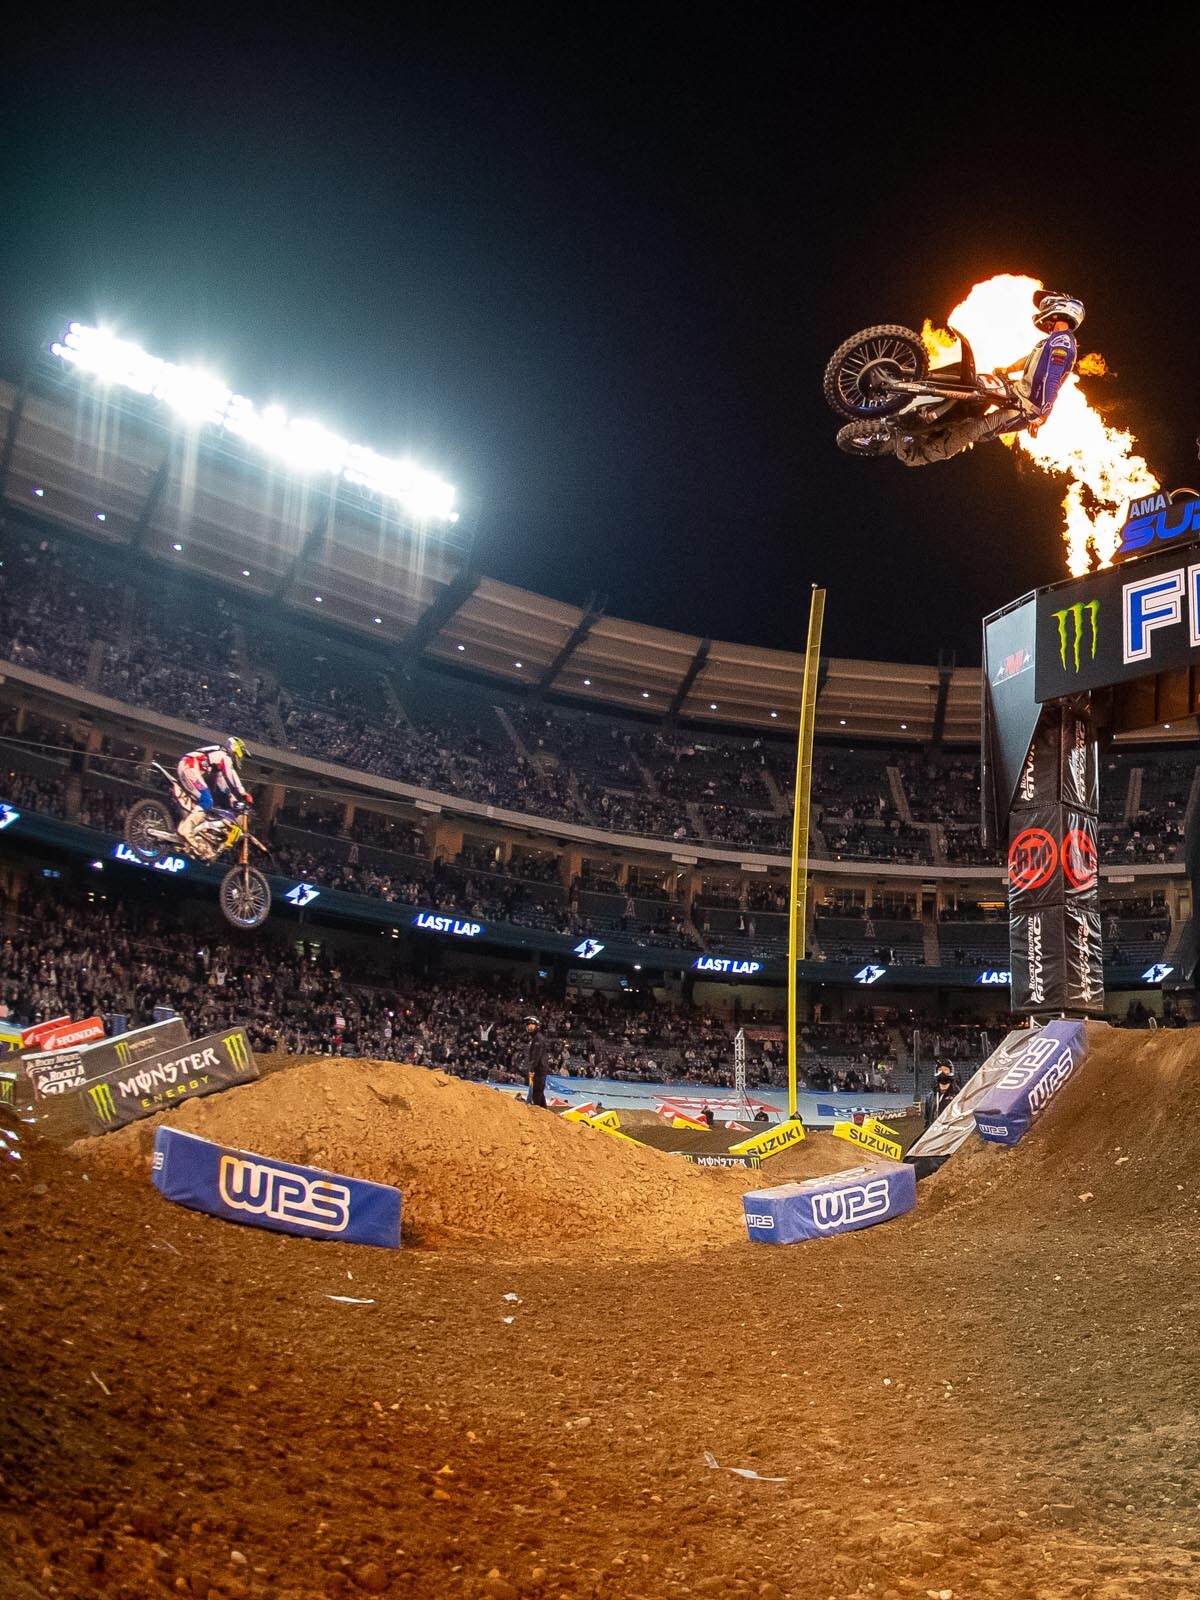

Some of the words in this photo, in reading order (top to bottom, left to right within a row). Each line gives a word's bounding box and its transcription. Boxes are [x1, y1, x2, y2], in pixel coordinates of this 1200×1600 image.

[1130, 494, 1166, 518] AMA
[417, 913, 453, 932] LAST
[453, 920, 481, 937] LAP
[697, 957, 731, 972] LAST
[732, 960, 760, 974] LAP
[56, 1026, 103, 1047] HONDA
[50, 1068, 77, 1081] ROCKY
[996, 1038, 1060, 1090] WPS
[142, 1076, 209, 1108] ENERGY
[1028, 1047, 1073, 1115] WPS
[746, 1126, 801, 1156] SUZUKI
[978, 1123, 1008, 1136] WPS
[849, 1128, 898, 1159] SUZUKI
[218, 1155, 351, 1232] WPS
[811, 1179, 890, 1230] WPS
[746, 1213, 774, 1229] WPS
